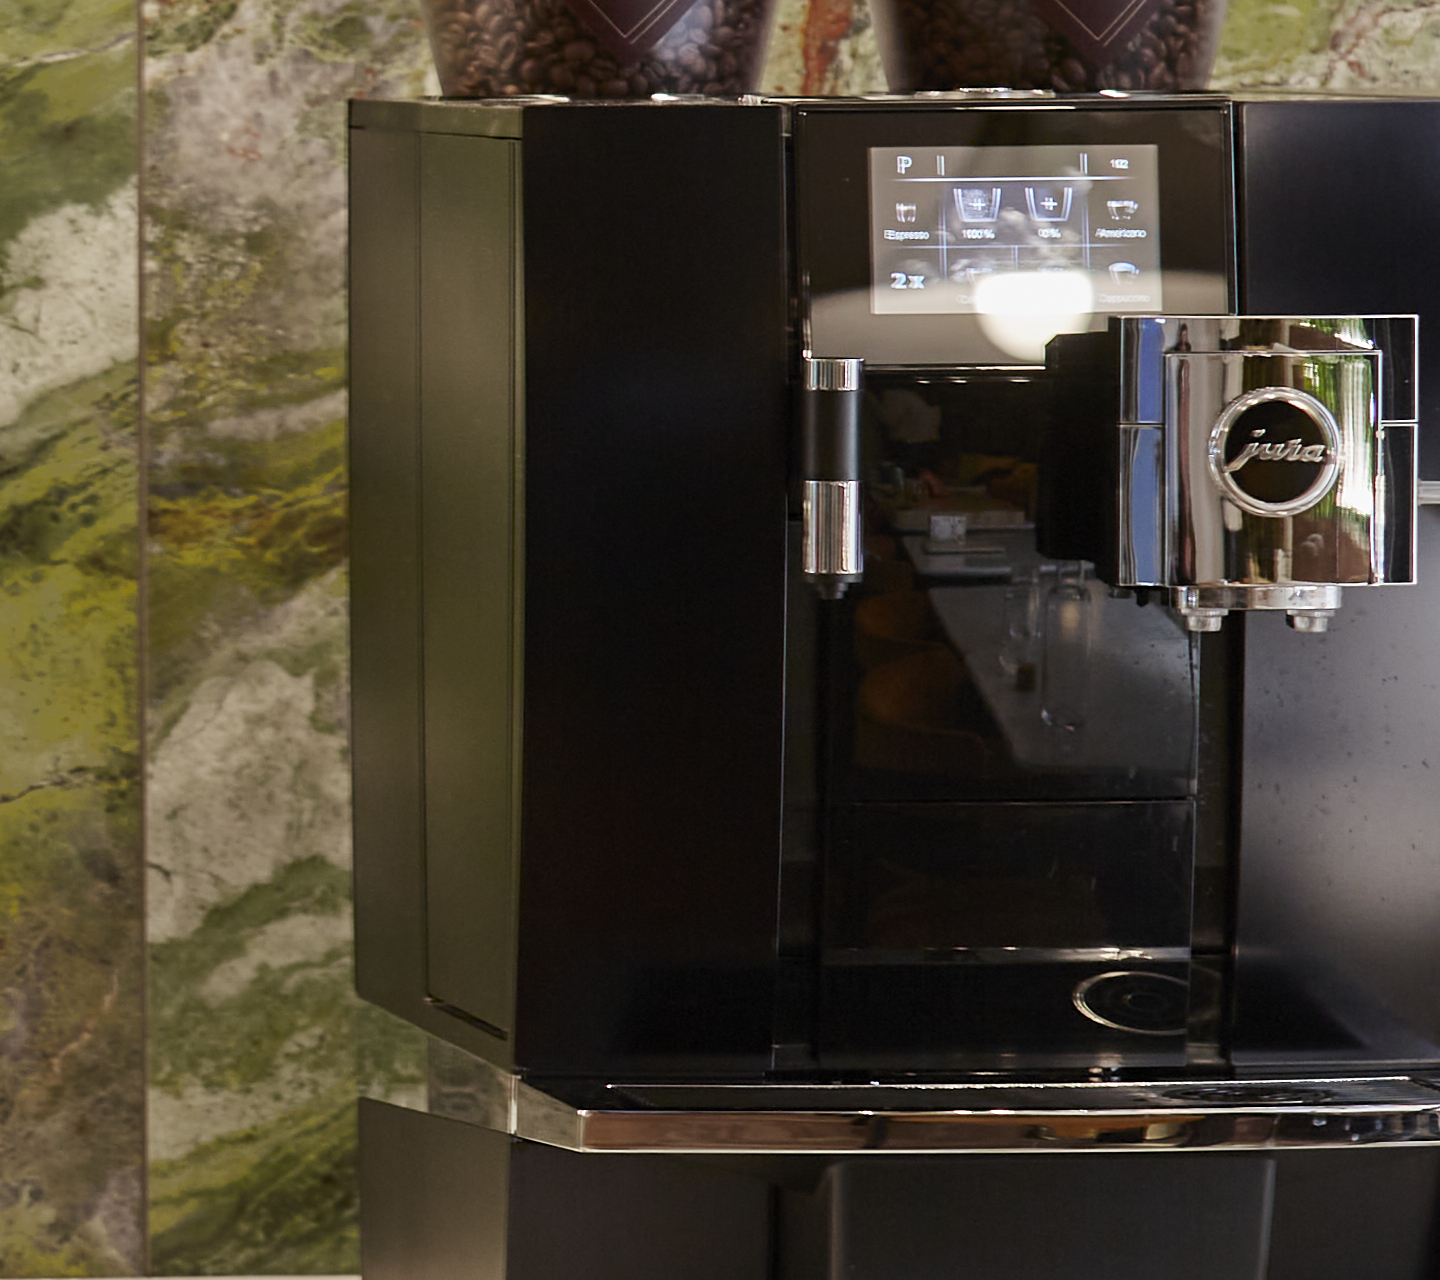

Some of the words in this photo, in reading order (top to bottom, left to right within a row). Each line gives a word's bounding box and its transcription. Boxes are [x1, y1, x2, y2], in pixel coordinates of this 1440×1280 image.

[883, 229, 930, 242] Espresso
[1094, 228, 1148, 238] Americano
[1222, 428, 1326, 473] jura
